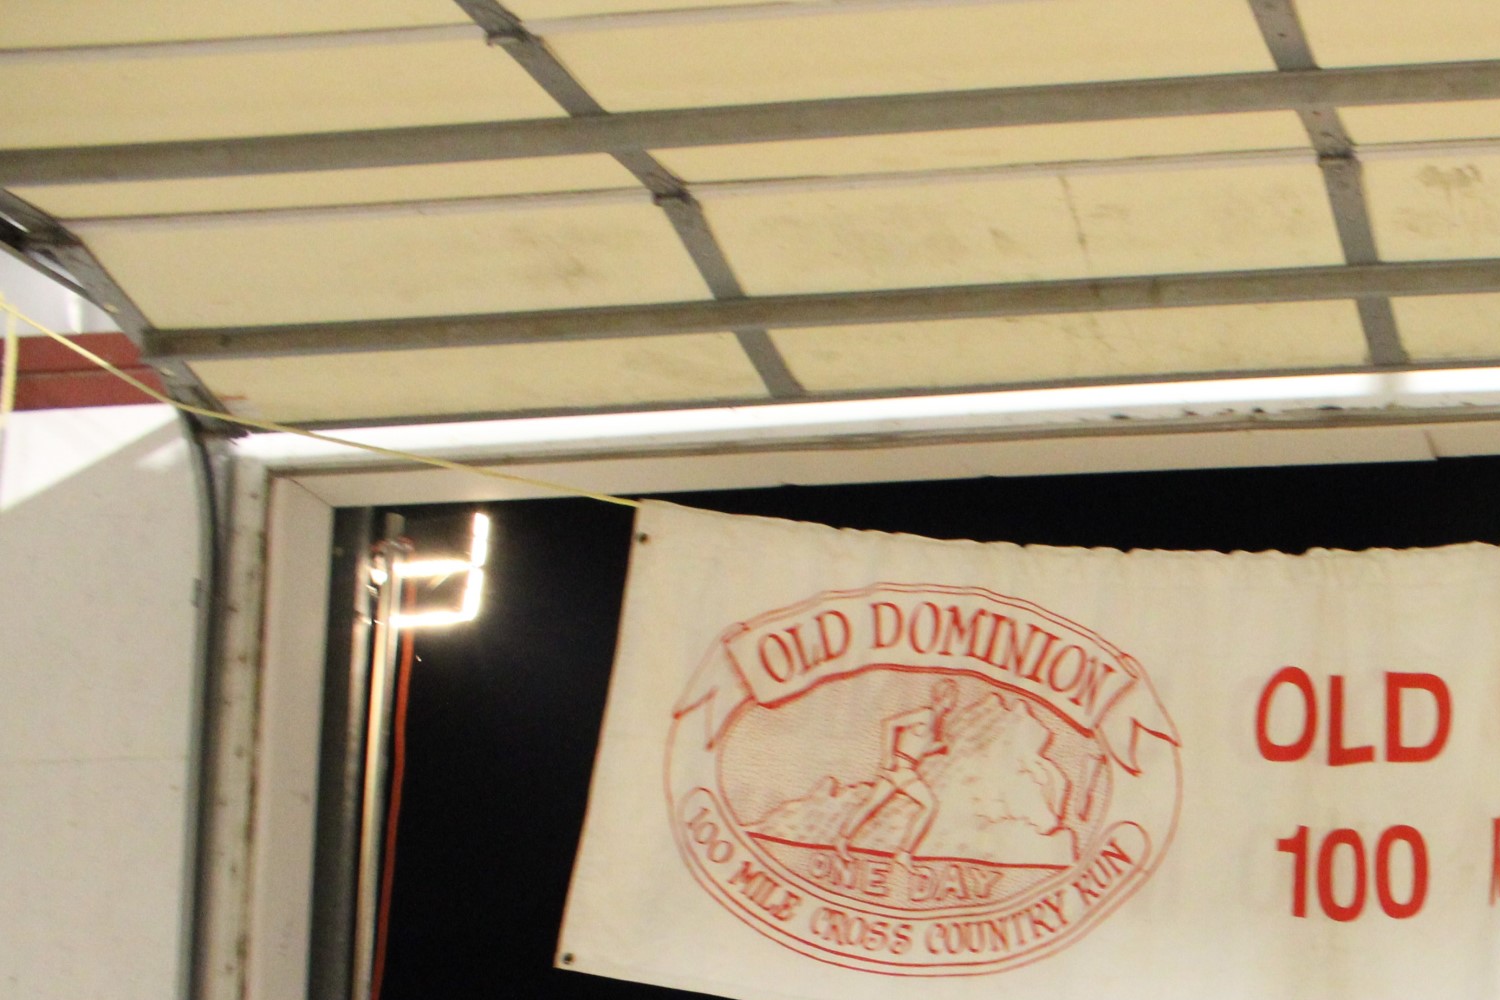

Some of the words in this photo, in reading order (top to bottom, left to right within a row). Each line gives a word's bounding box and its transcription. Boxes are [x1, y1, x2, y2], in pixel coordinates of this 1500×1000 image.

[758, 609, 852, 683] OLD
[870, 601, 1117, 717] DOMINION
[1255, 665, 1454, 767] OLD
[686, 807, 735, 864] 100
[726, 860, 802, 922] MILE
[809, 906, 914, 955] CROSS
[924, 889, 1069, 954] COUNTRY
[1072, 836, 1133, 907] RUN
[807, 852, 892, 898] ONE
[908, 864, 1006, 902] DAY
[1275, 824, 1430, 923] 100
